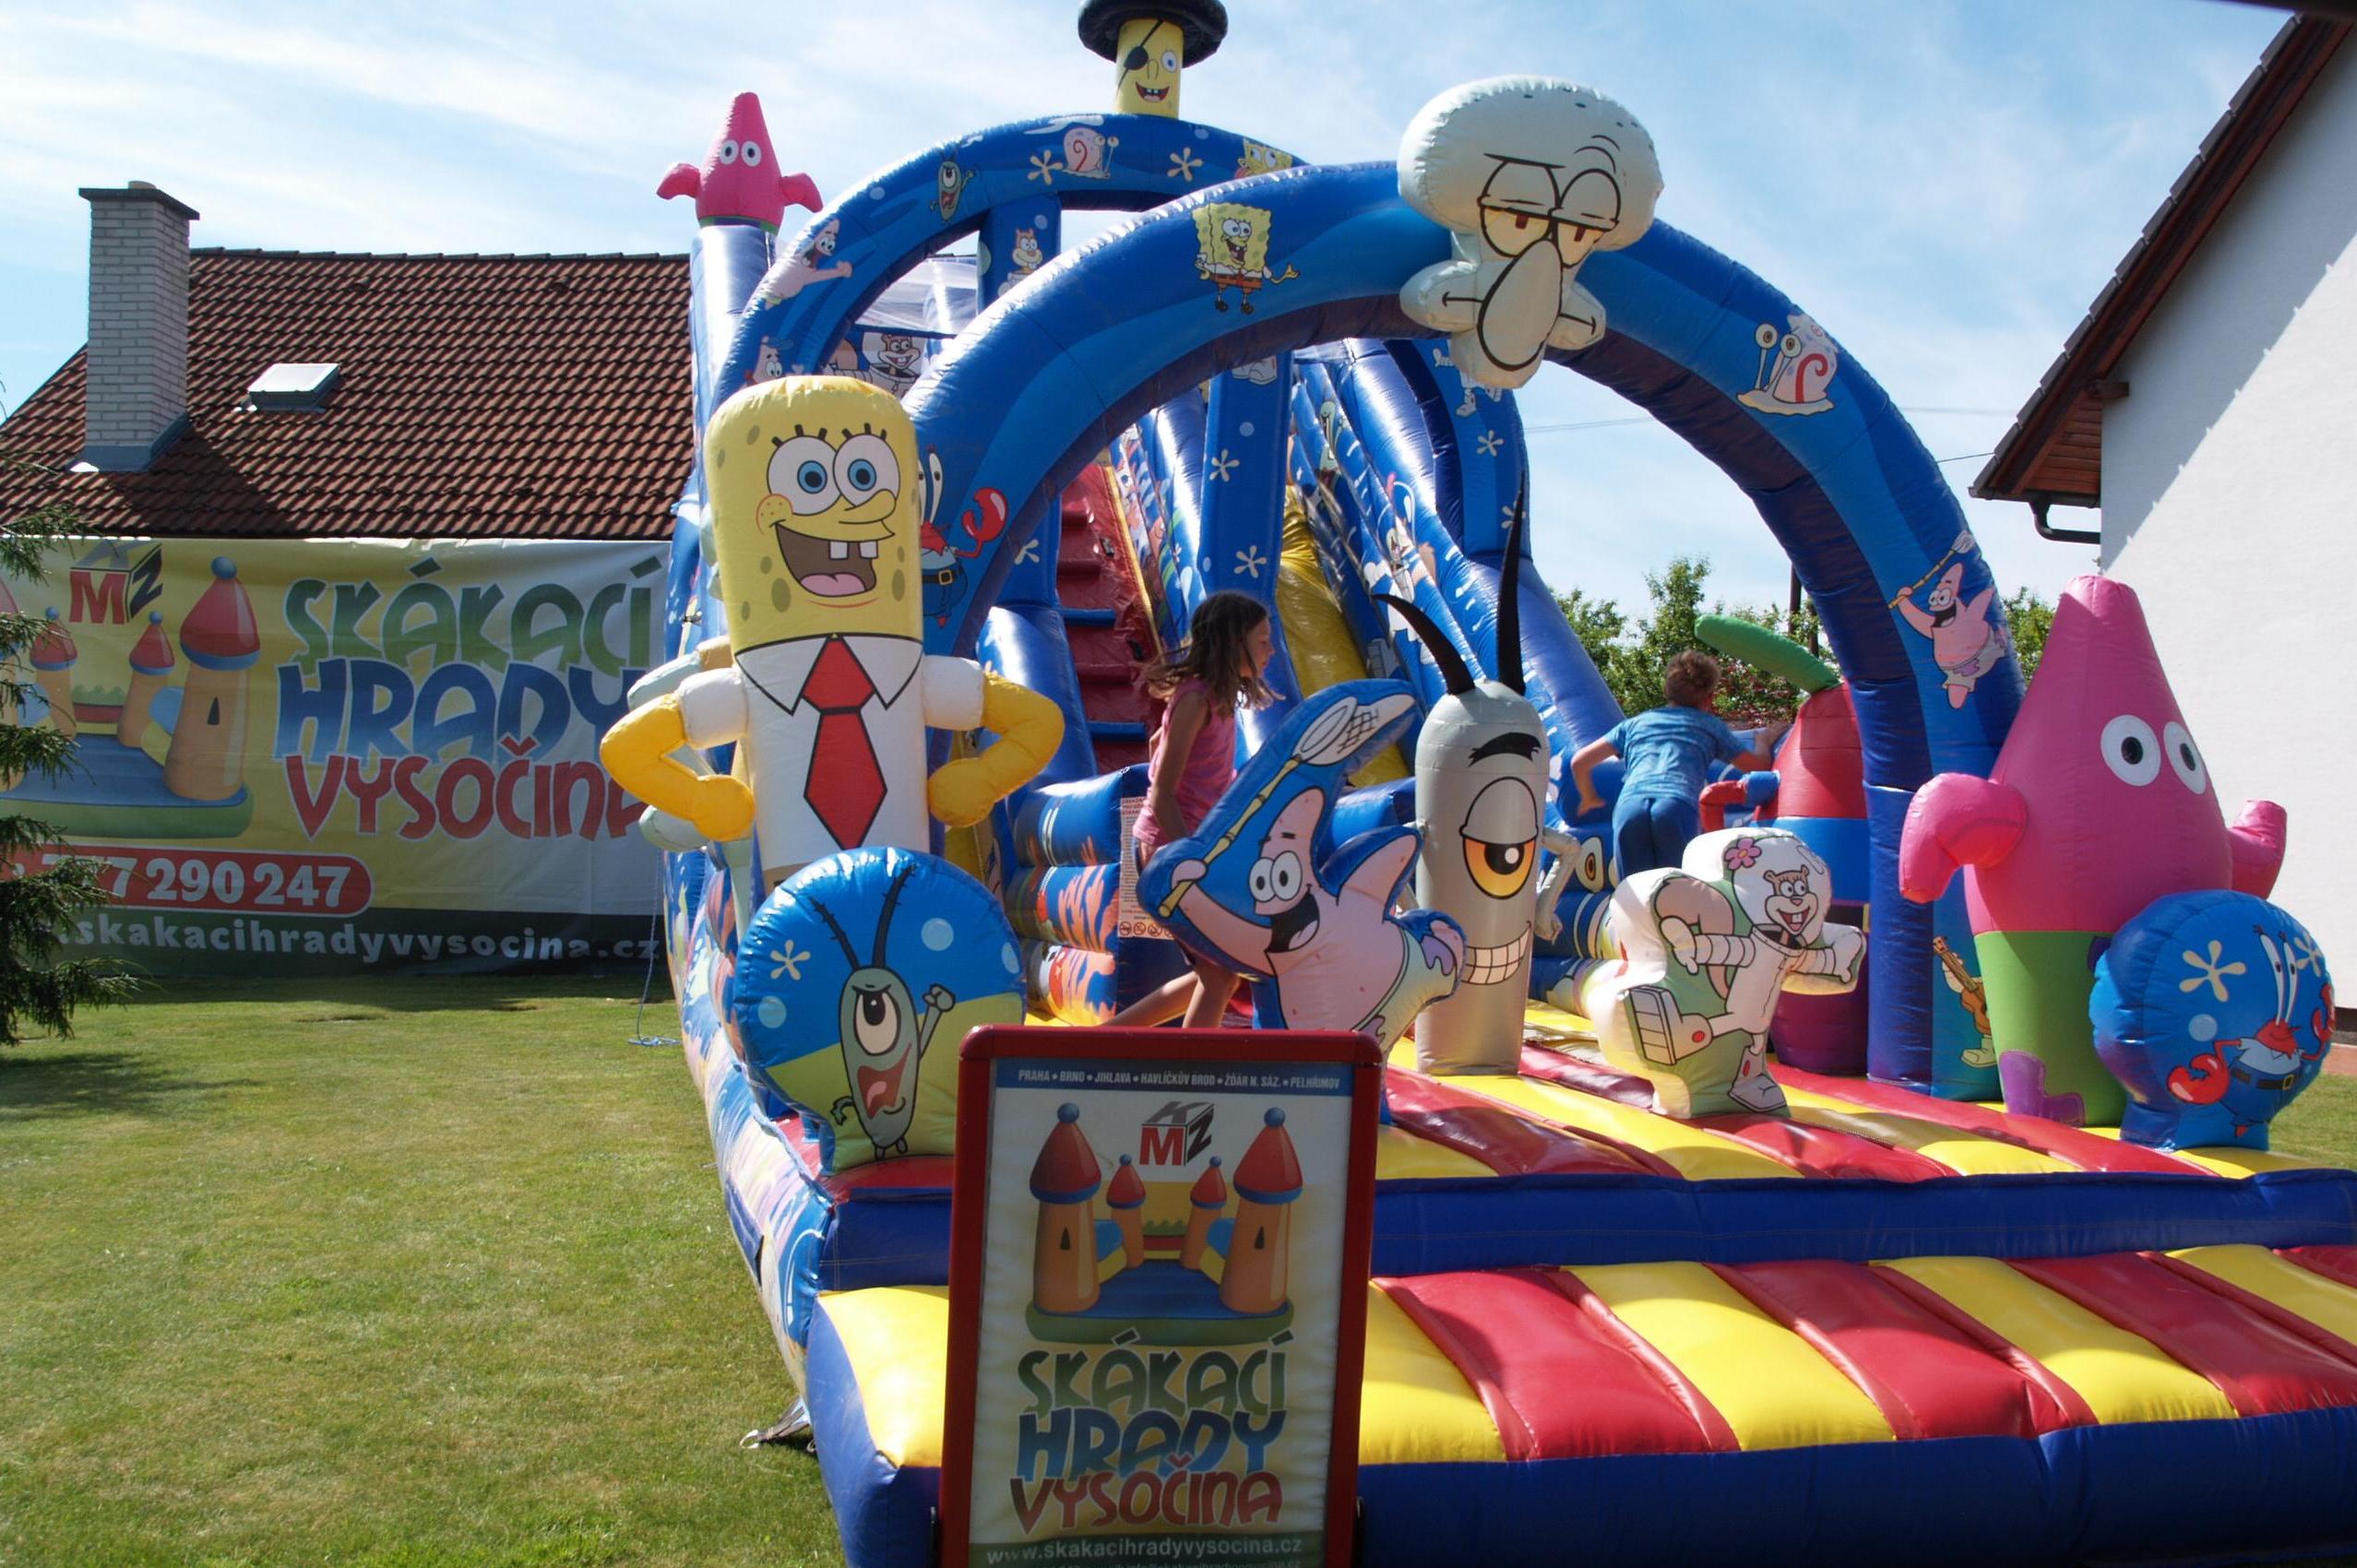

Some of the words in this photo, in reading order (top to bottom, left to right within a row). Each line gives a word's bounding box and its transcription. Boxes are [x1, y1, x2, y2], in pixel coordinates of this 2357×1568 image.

[284, 555, 661, 678] SKÁKACÍ
[274, 658, 648, 763] HRADY
[146, 858, 245, 904] 290
[254, 862, 351, 908] 247
[1018, 1069, 1050, 1082] PRAHA
[1060, 1071, 1085, 1083] BRNO
[1094, 1072, 1131, 1084] JIHLAVA
[1140, 1071, 1191, 1086] HAVLÍČKŮV
[1191, 1074, 1216, 1087] BROD
[1249, 1076, 1260, 1087] N.
[1260, 1074, 1280, 1088] SÁZ.
[1290, 1075, 1340, 1089] PELHŘIMOV
[1018, 1328, 1294, 1421] SKÁKACÍ
[1017, 1407, 1288, 1483] HRADY
[1010, 1453, 1283, 1536] VYSOČINA
[986, 1537, 1303, 1566] www.skakacihradyvysocina.cz
